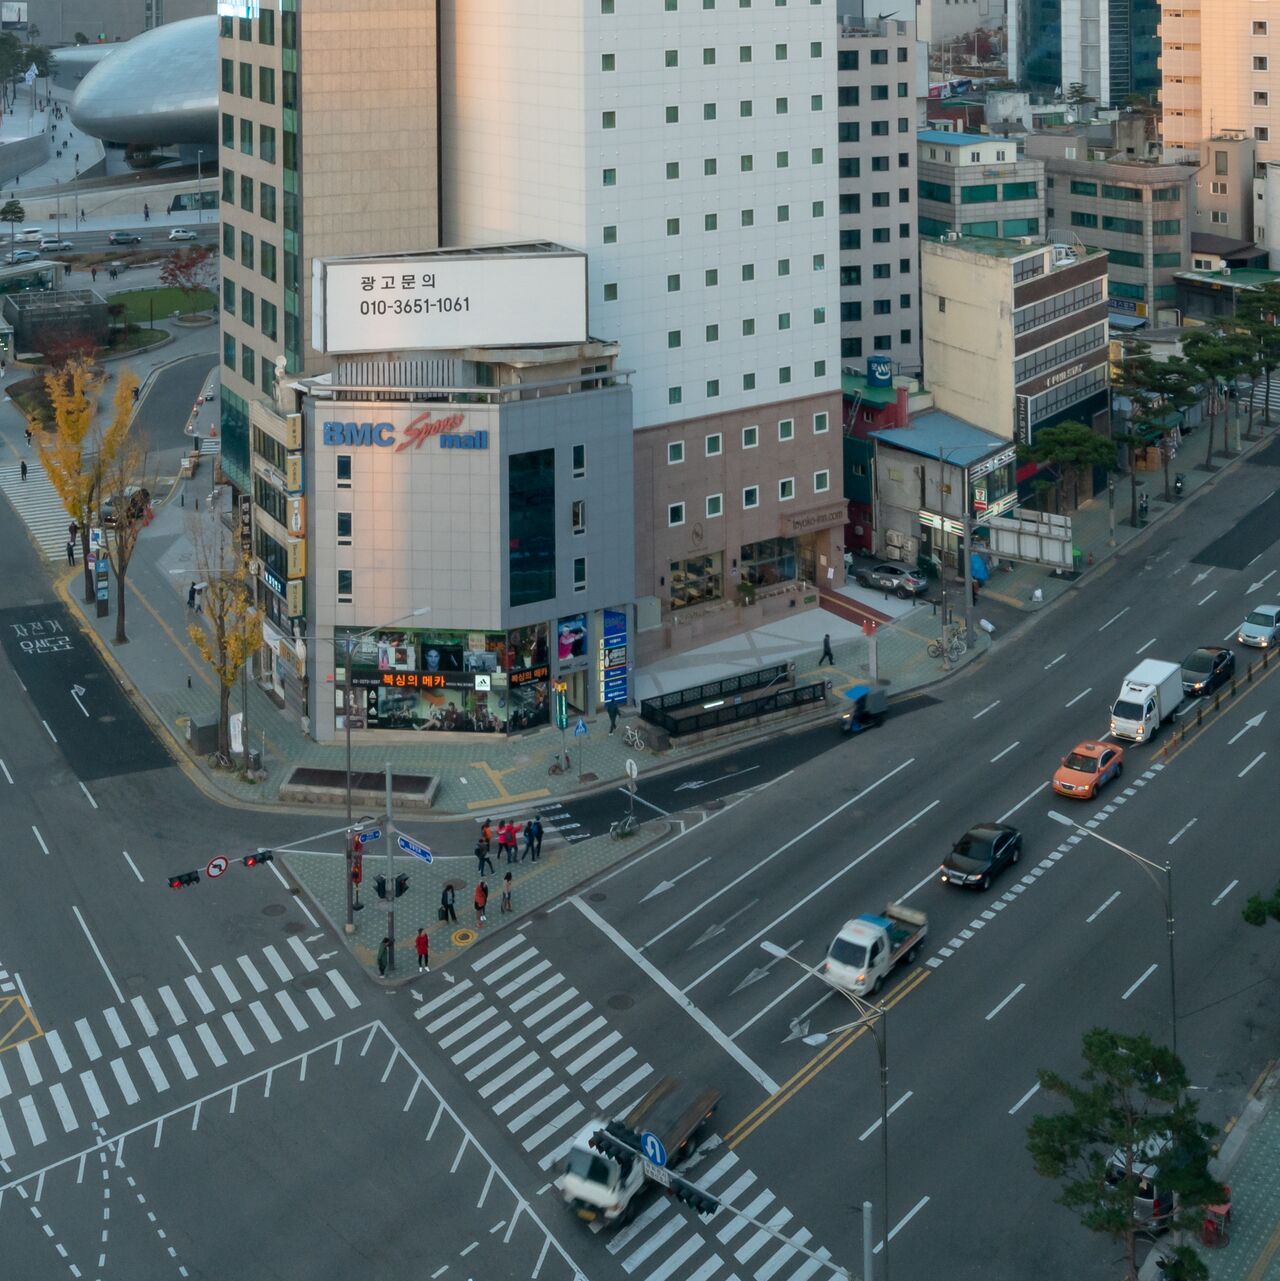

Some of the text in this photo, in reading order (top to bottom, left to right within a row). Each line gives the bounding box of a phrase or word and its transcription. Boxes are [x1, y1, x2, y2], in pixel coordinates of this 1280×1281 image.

[360, 273, 436, 292] 광고문의
[360, 296, 470, 316] 010-3651-1061
[322, 421, 397, 448] BMC
[395, 409, 466, 453] Sports
[439, 430, 490, 450] mall
[383, 673, 418, 687] 복싱의
[421, 674, 446, 688] 메카
